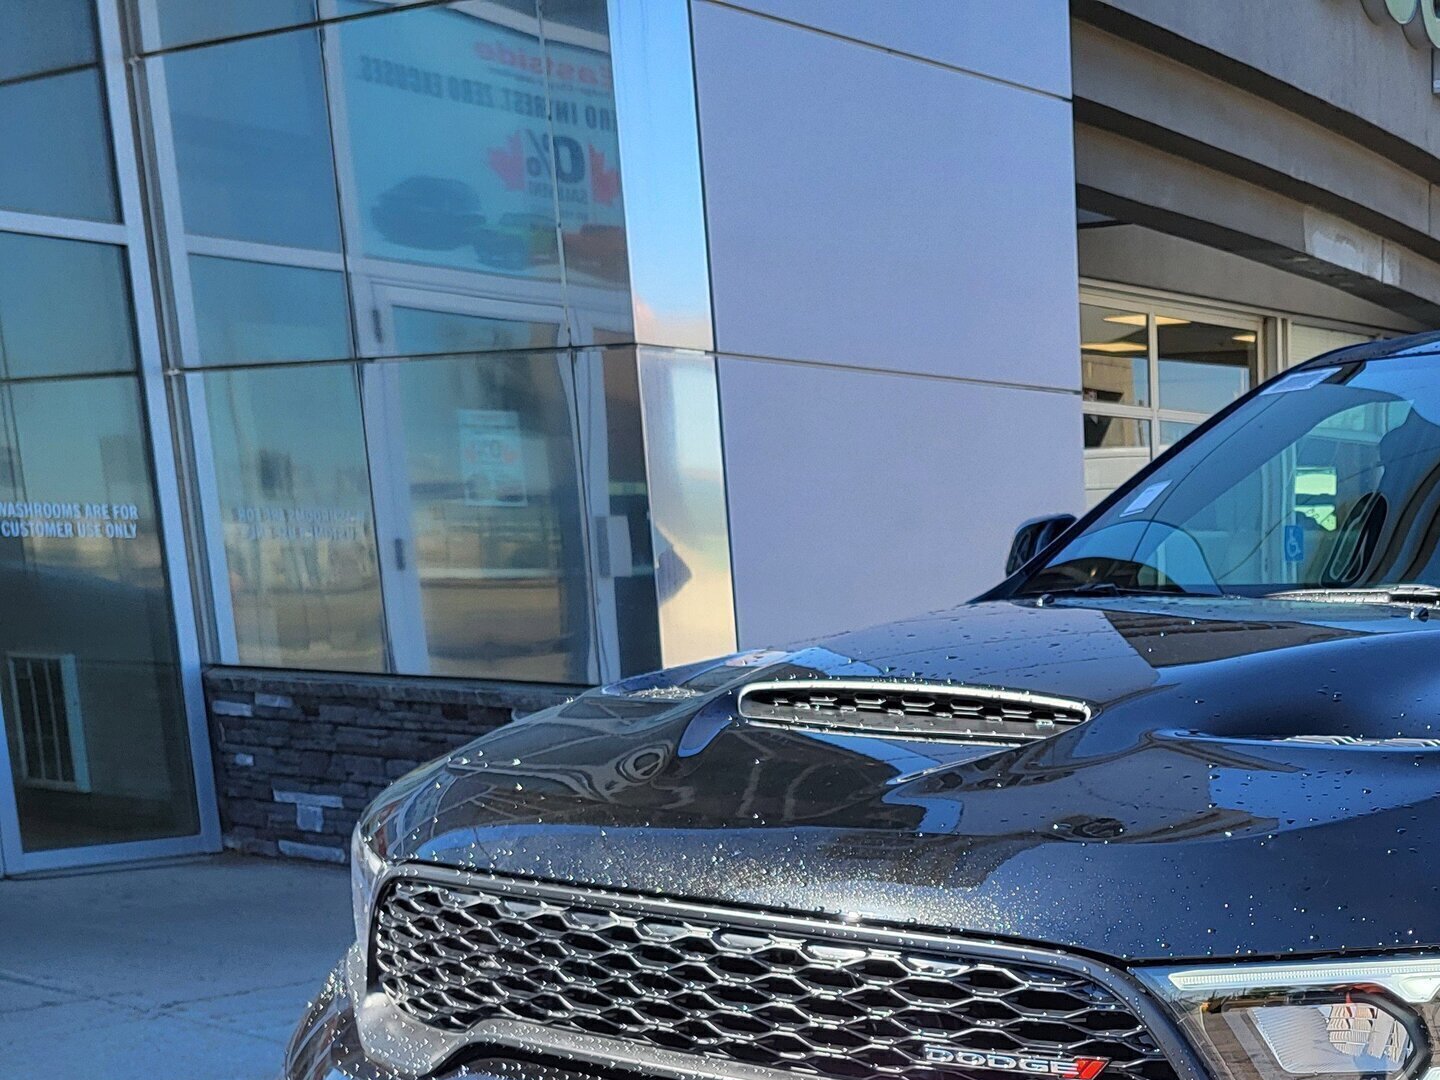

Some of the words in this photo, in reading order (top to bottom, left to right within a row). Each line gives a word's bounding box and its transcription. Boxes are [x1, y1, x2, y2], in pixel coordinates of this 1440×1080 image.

[85, 503, 110, 520] ARE
[112, 504, 138, 520] FOR
[1, 520, 74, 538] CUSTOMER
[77, 521, 102, 538] USE
[105, 521, 137, 539] ONLY
[925, 1047, 1080, 1076] DODGE
